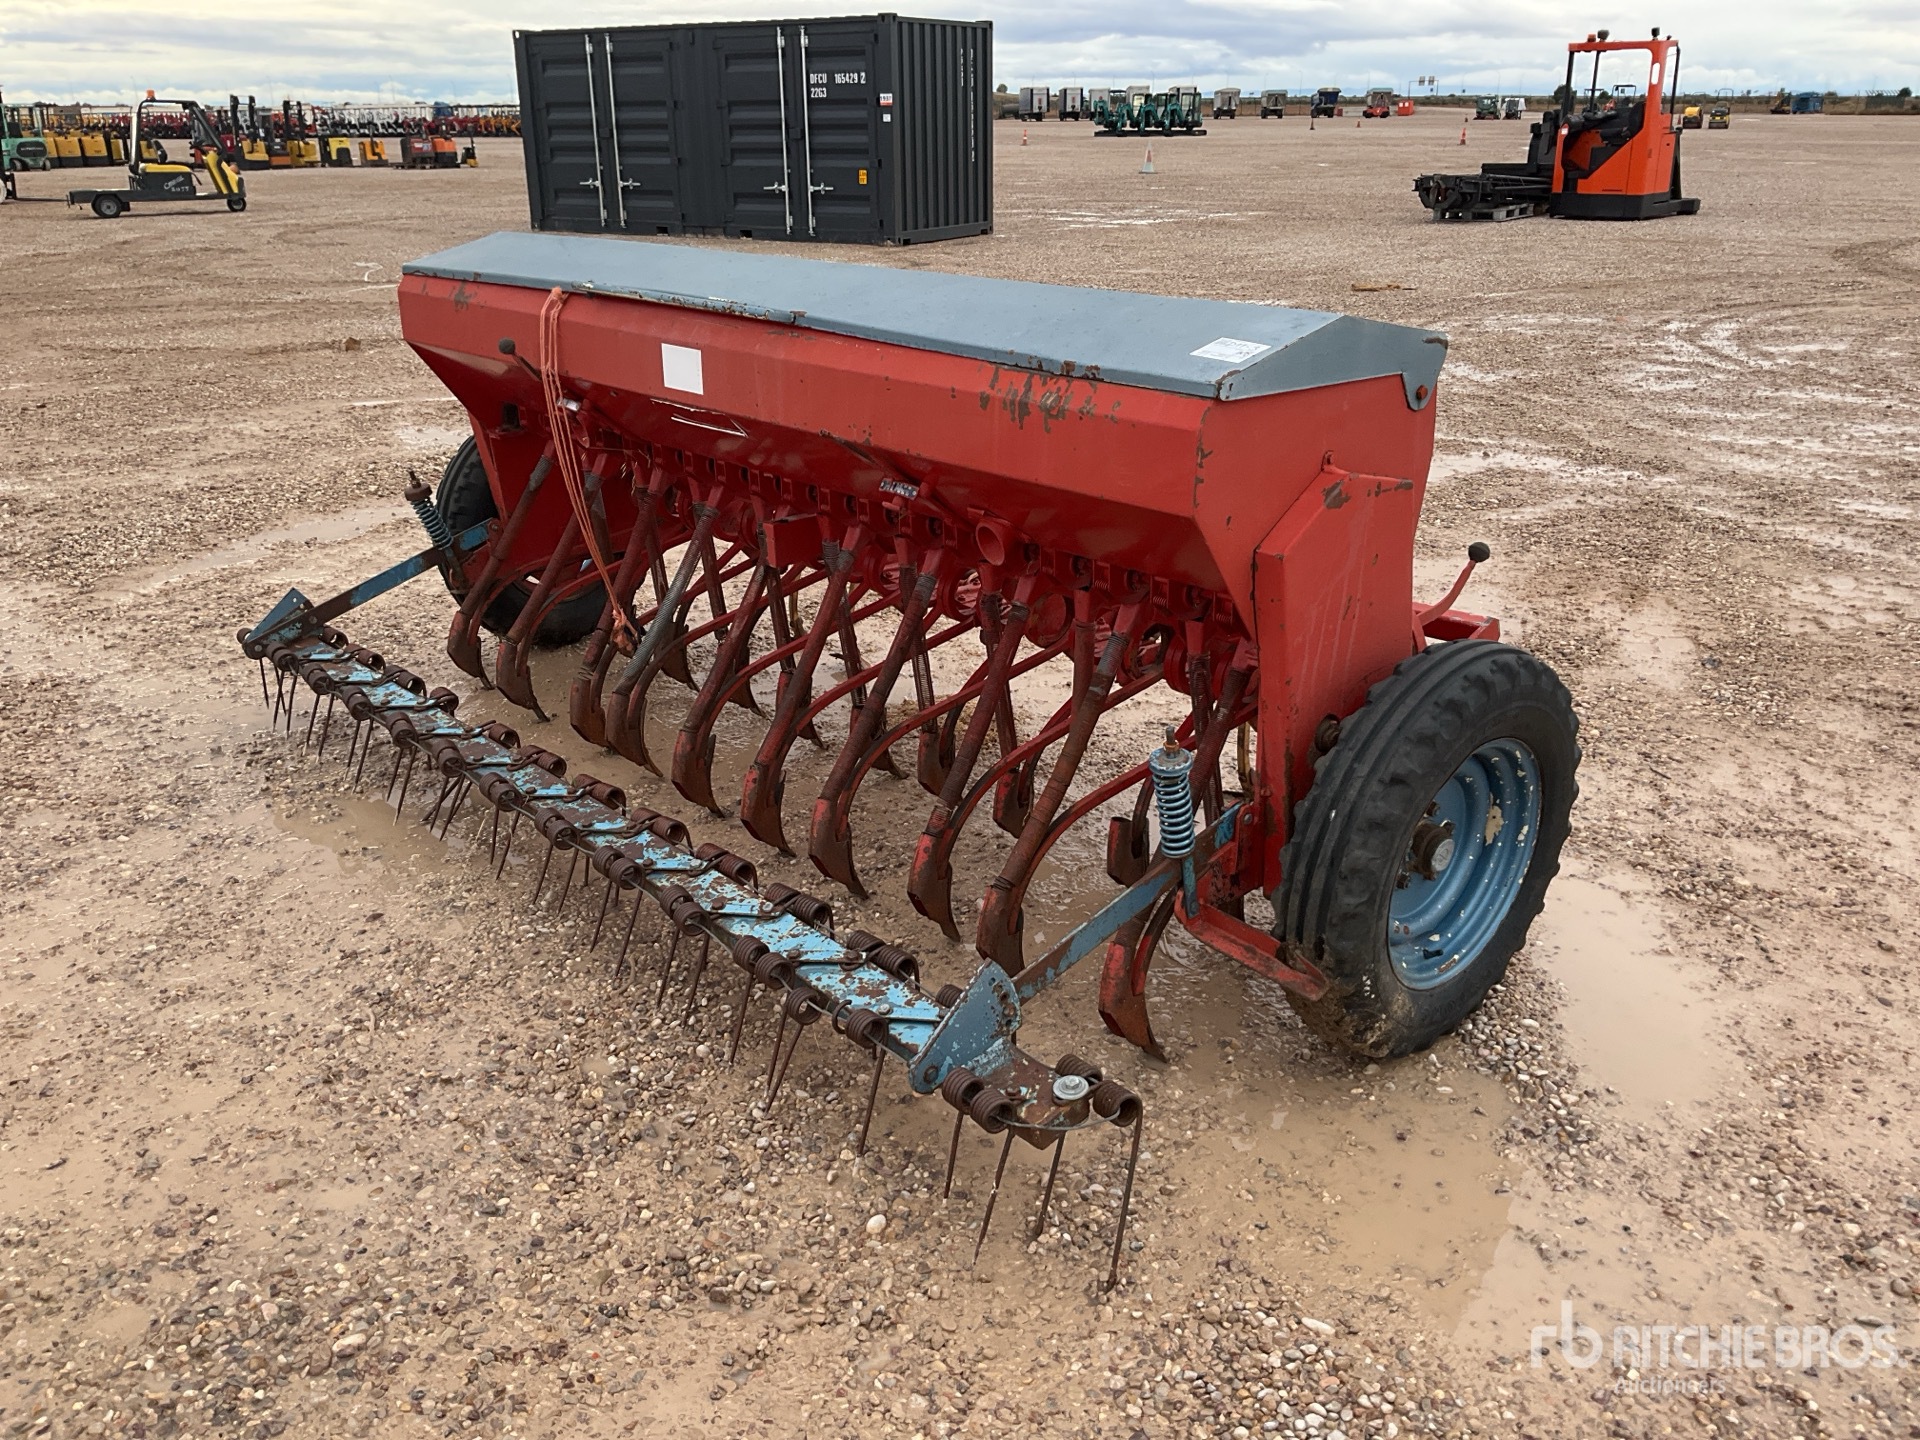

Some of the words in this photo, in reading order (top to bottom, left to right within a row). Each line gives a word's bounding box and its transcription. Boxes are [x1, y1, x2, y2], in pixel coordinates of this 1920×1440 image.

[810, 73, 827, 84] DFCU
[834, 72, 858, 84] 165429
[860, 71, 866, 84] 2
[810, 87, 827, 98] 22G3
